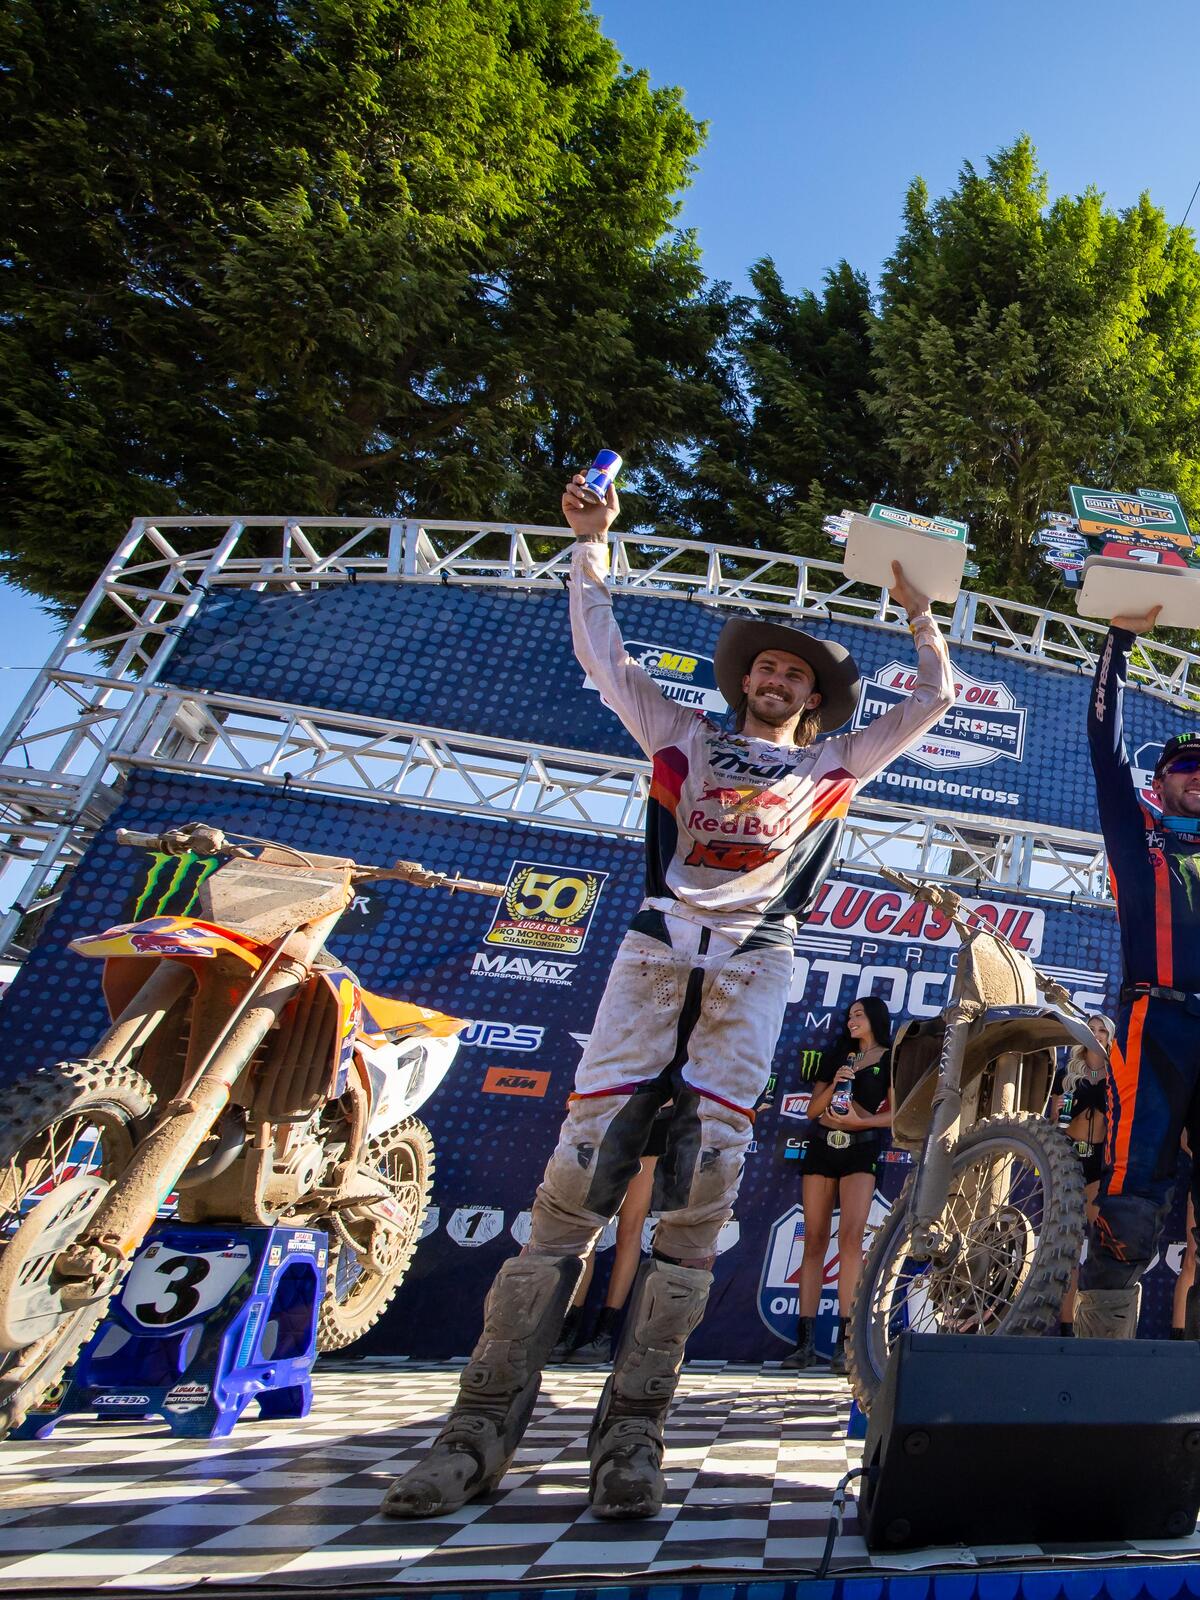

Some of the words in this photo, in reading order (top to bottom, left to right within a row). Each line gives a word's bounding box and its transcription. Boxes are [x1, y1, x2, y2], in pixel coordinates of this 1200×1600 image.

[1141, 490, 1158, 498] EXIT
[1086, 499, 1118, 510] SOUTH
[1116, 500, 1172, 519] WICK
[1121, 514, 1144, 524] 338
[1041, 536, 1087, 547] MOTOCROSS
[1106, 533, 1138, 542] FIRST
[1139, 538, 1174, 548] PLACE
[1136, 543, 1169, 551] CLASS
[657, 652, 699, 673] MB
[890, 672, 963, 699] LUS
[965, 687, 1000, 707] OIL
[864, 698, 1018, 740] MCROSS
[917, 744, 945, 757] AMA
[688, 810, 740, 835] Red
[743, 816, 792, 837] Bull
[684, 840, 784, 873] KTM
[513, 871, 589, 919] 50
[808, 884, 952, 941] LUCAS
[965, 904, 1034, 951] OIL
[517, 920, 546, 932] LUCAS
[547, 925, 561, 933] OIL
[494, 927, 514, 936] PRO
[516, 930, 579, 944] MOTOCROSS
[502, 936, 565, 949] CHAMPIONSHIP
[470, 970, 532, 982] MOTORSPORTS
[533, 977, 573, 987] NETWORK
[460, 1020, 543, 1051] UPS
[495, 1075, 537, 1090] KTM
[787, 1100, 811, 1113] 100
[136, 1255, 211, 1325] 3
[92, 1396, 150, 1405] ACERBIS
